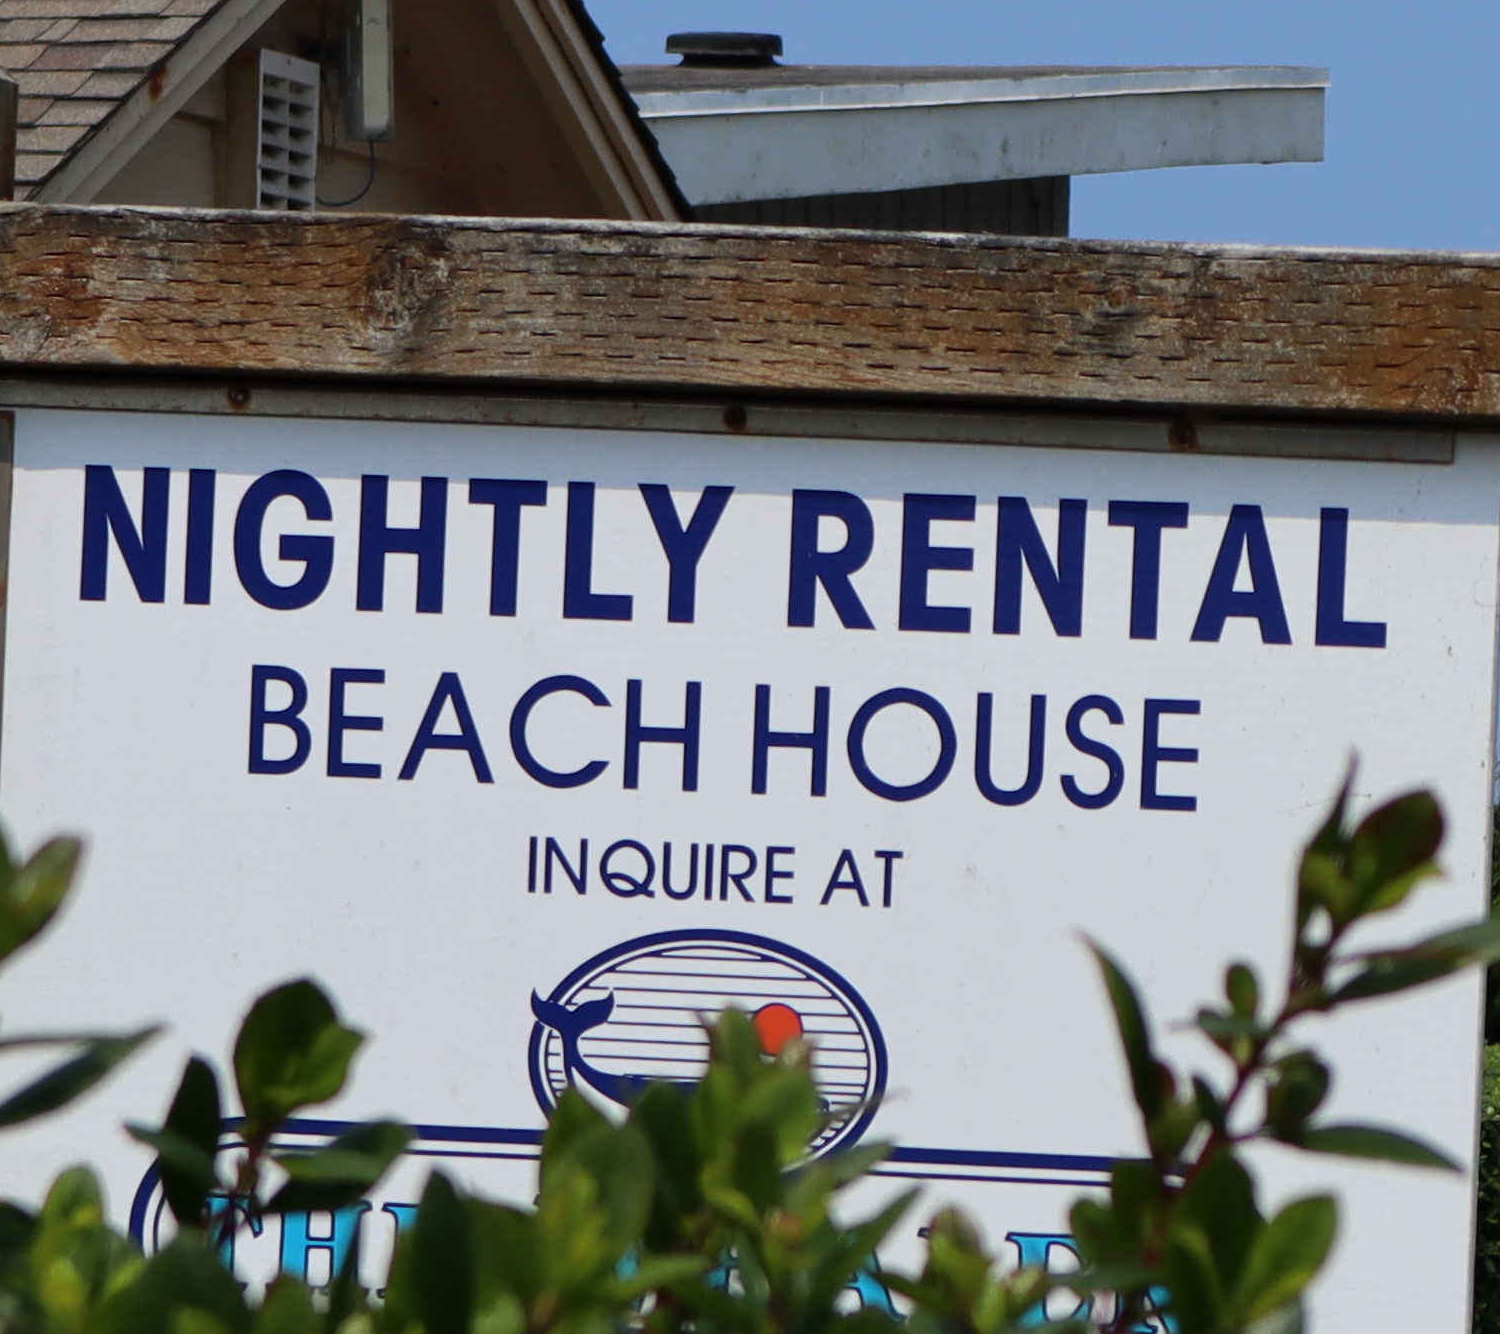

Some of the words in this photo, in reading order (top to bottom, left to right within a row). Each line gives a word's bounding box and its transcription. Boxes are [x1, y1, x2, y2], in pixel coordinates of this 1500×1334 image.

[79, 463, 737, 624] NIGHTLY
[787, 487, 1387, 649] RENTAL
[247, 664, 702, 792] BEACH
[751, 683, 1201, 812] HOUSE
[527, 836, 796, 904] INQUIRE
[820, 848, 904, 908] AT
